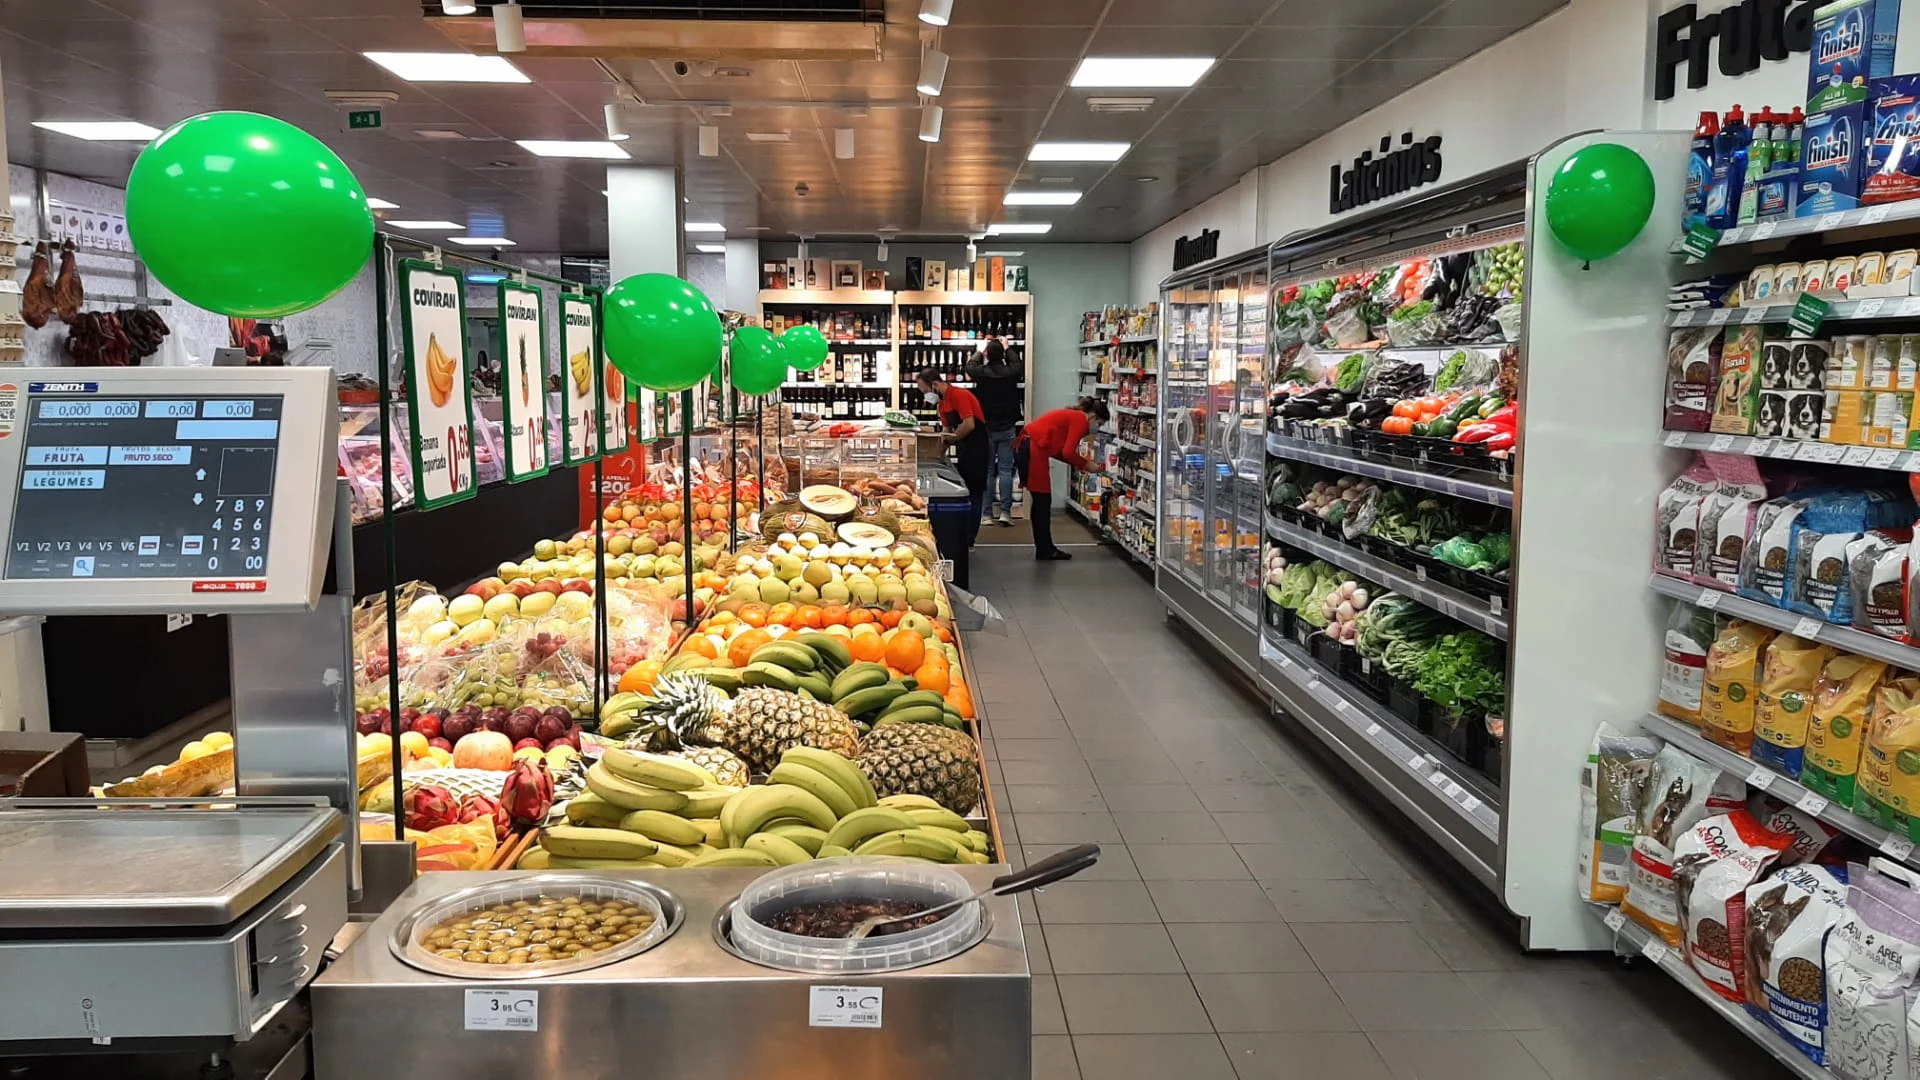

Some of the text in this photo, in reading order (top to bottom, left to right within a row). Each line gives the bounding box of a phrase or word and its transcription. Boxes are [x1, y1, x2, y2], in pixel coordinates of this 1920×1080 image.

[1820, 23, 1859, 59] finish
[1876, 113, 1920, 140] finis
[1808, 132, 1847, 164] finish
[58, 405, 251, 416] 0,000 0,000 0,00 0,00
[44, 453, 84, 463] FRUTA
[423, 453, 446, 475] mportada
[33, 477, 93, 487] LEGUMES
[215, 500, 264, 512] 7 8 9
[212, 518, 262, 531] 4 5 6
[16, 542, 135, 551] V1 V2 V3 V4 V5 V6
[212, 537, 260, 550] 1 2 3
[208, 556, 262, 570] 0 00
